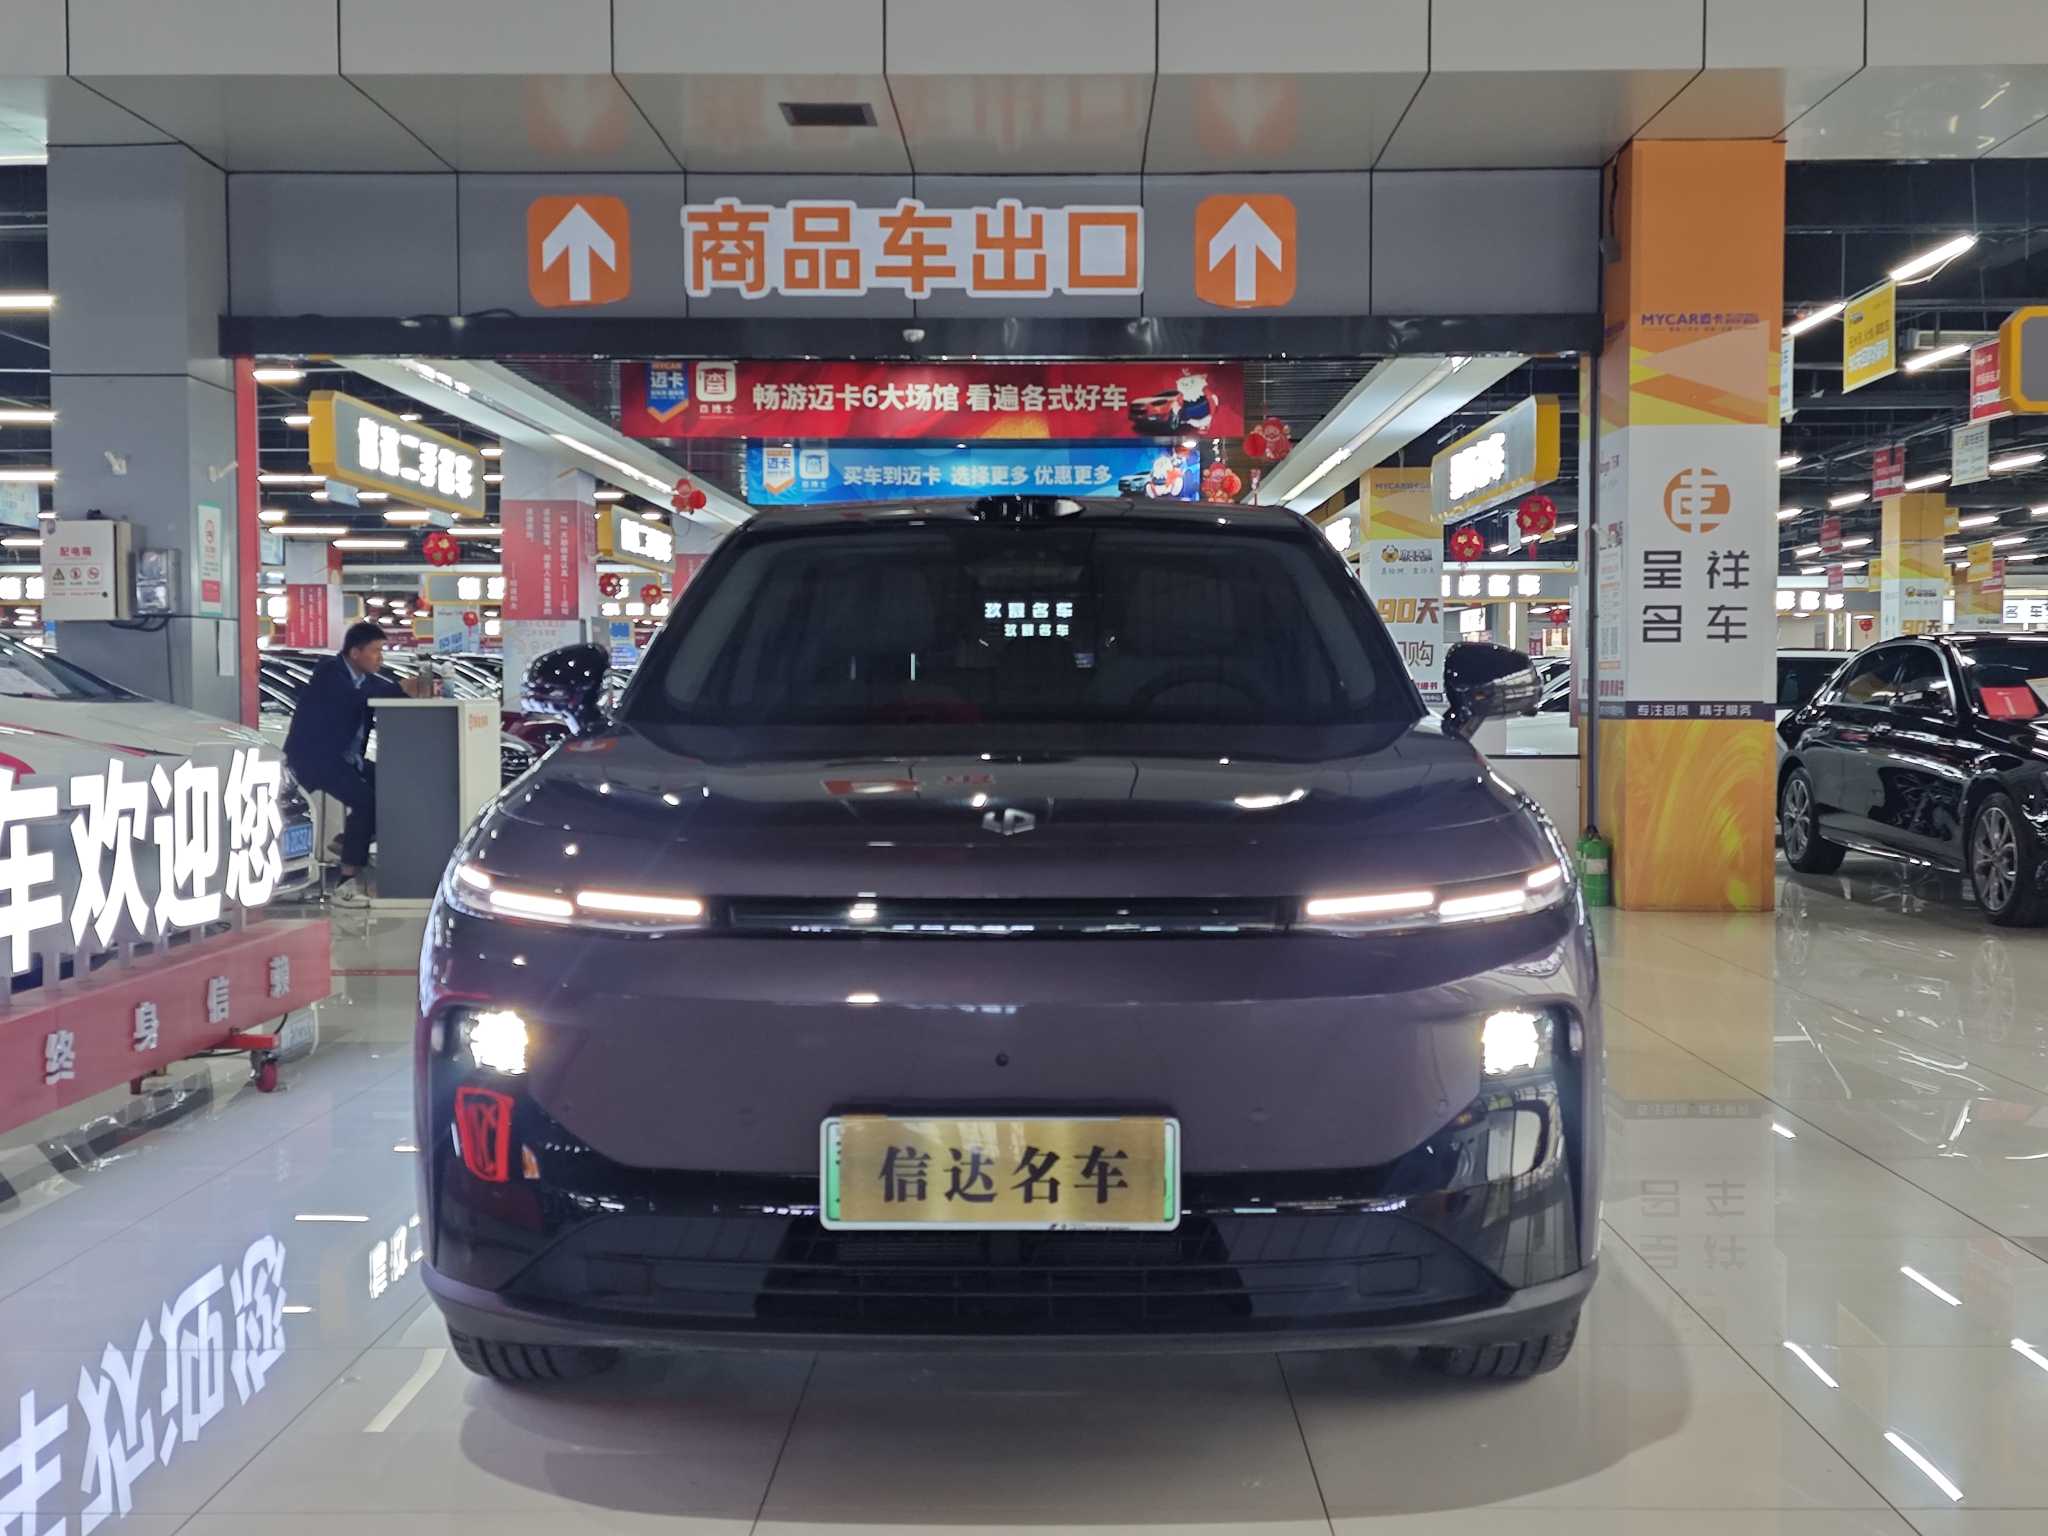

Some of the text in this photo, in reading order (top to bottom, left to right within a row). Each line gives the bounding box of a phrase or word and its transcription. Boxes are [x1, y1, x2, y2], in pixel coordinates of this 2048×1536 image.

[684, 202, 1142, 296] 商品车出口
[650, 371, 685, 389] 迈卡
[752, 384, 1128, 413] 畅游迈卡6大场馆 看遍各式好车
[843, 465, 941, 487] 买车到迈卡
[951, 464, 1029, 486] 选择更多
[1034, 463, 1113, 486] 优惠更多
[59, 547, 93, 557] 配电箱
[1643, 550, 1750, 589] 呈祥
[1377, 598, 1439, 624] 90天
[1643, 604, 1748, 643] 名车
[1637, 705, 1689, 717] 专注品质
[877, 1145, 1130, 1205] 信达名车
